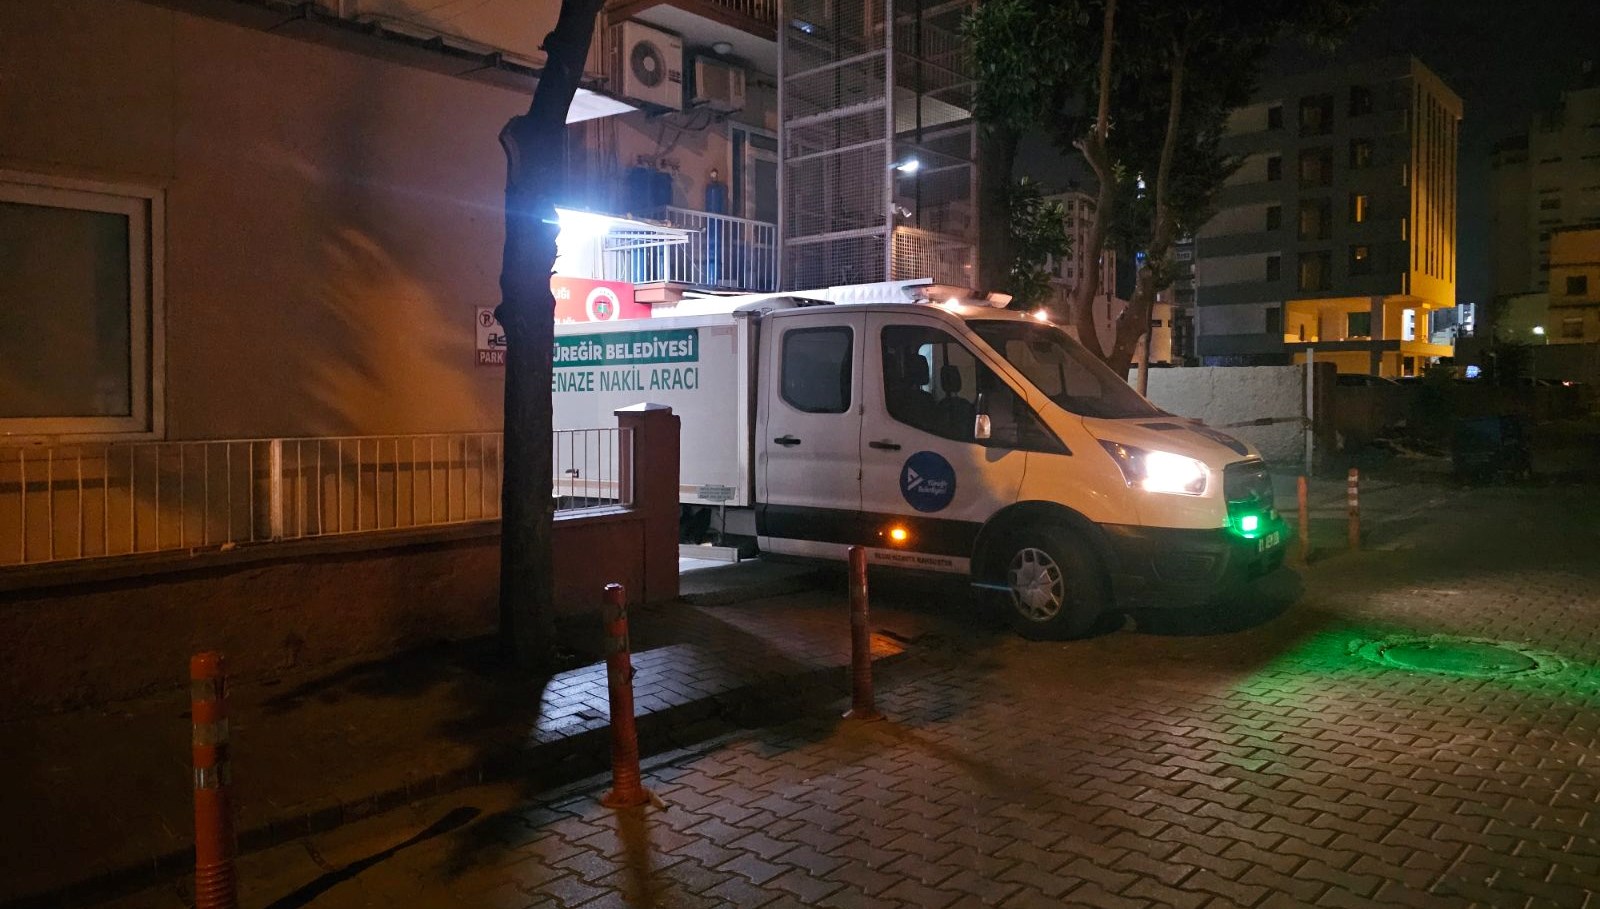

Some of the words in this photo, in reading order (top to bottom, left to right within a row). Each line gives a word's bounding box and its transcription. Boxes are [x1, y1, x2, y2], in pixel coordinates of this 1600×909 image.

[479, 351, 504, 364] PARK
[553, 341, 602, 361] ÜREĞİR
[606, 335, 693, 360] BELEDİYESİ
[552, 371, 595, 392] ENAZE
[600, 366, 645, 392] NAKİL
[649, 367, 699, 390] ARACI
